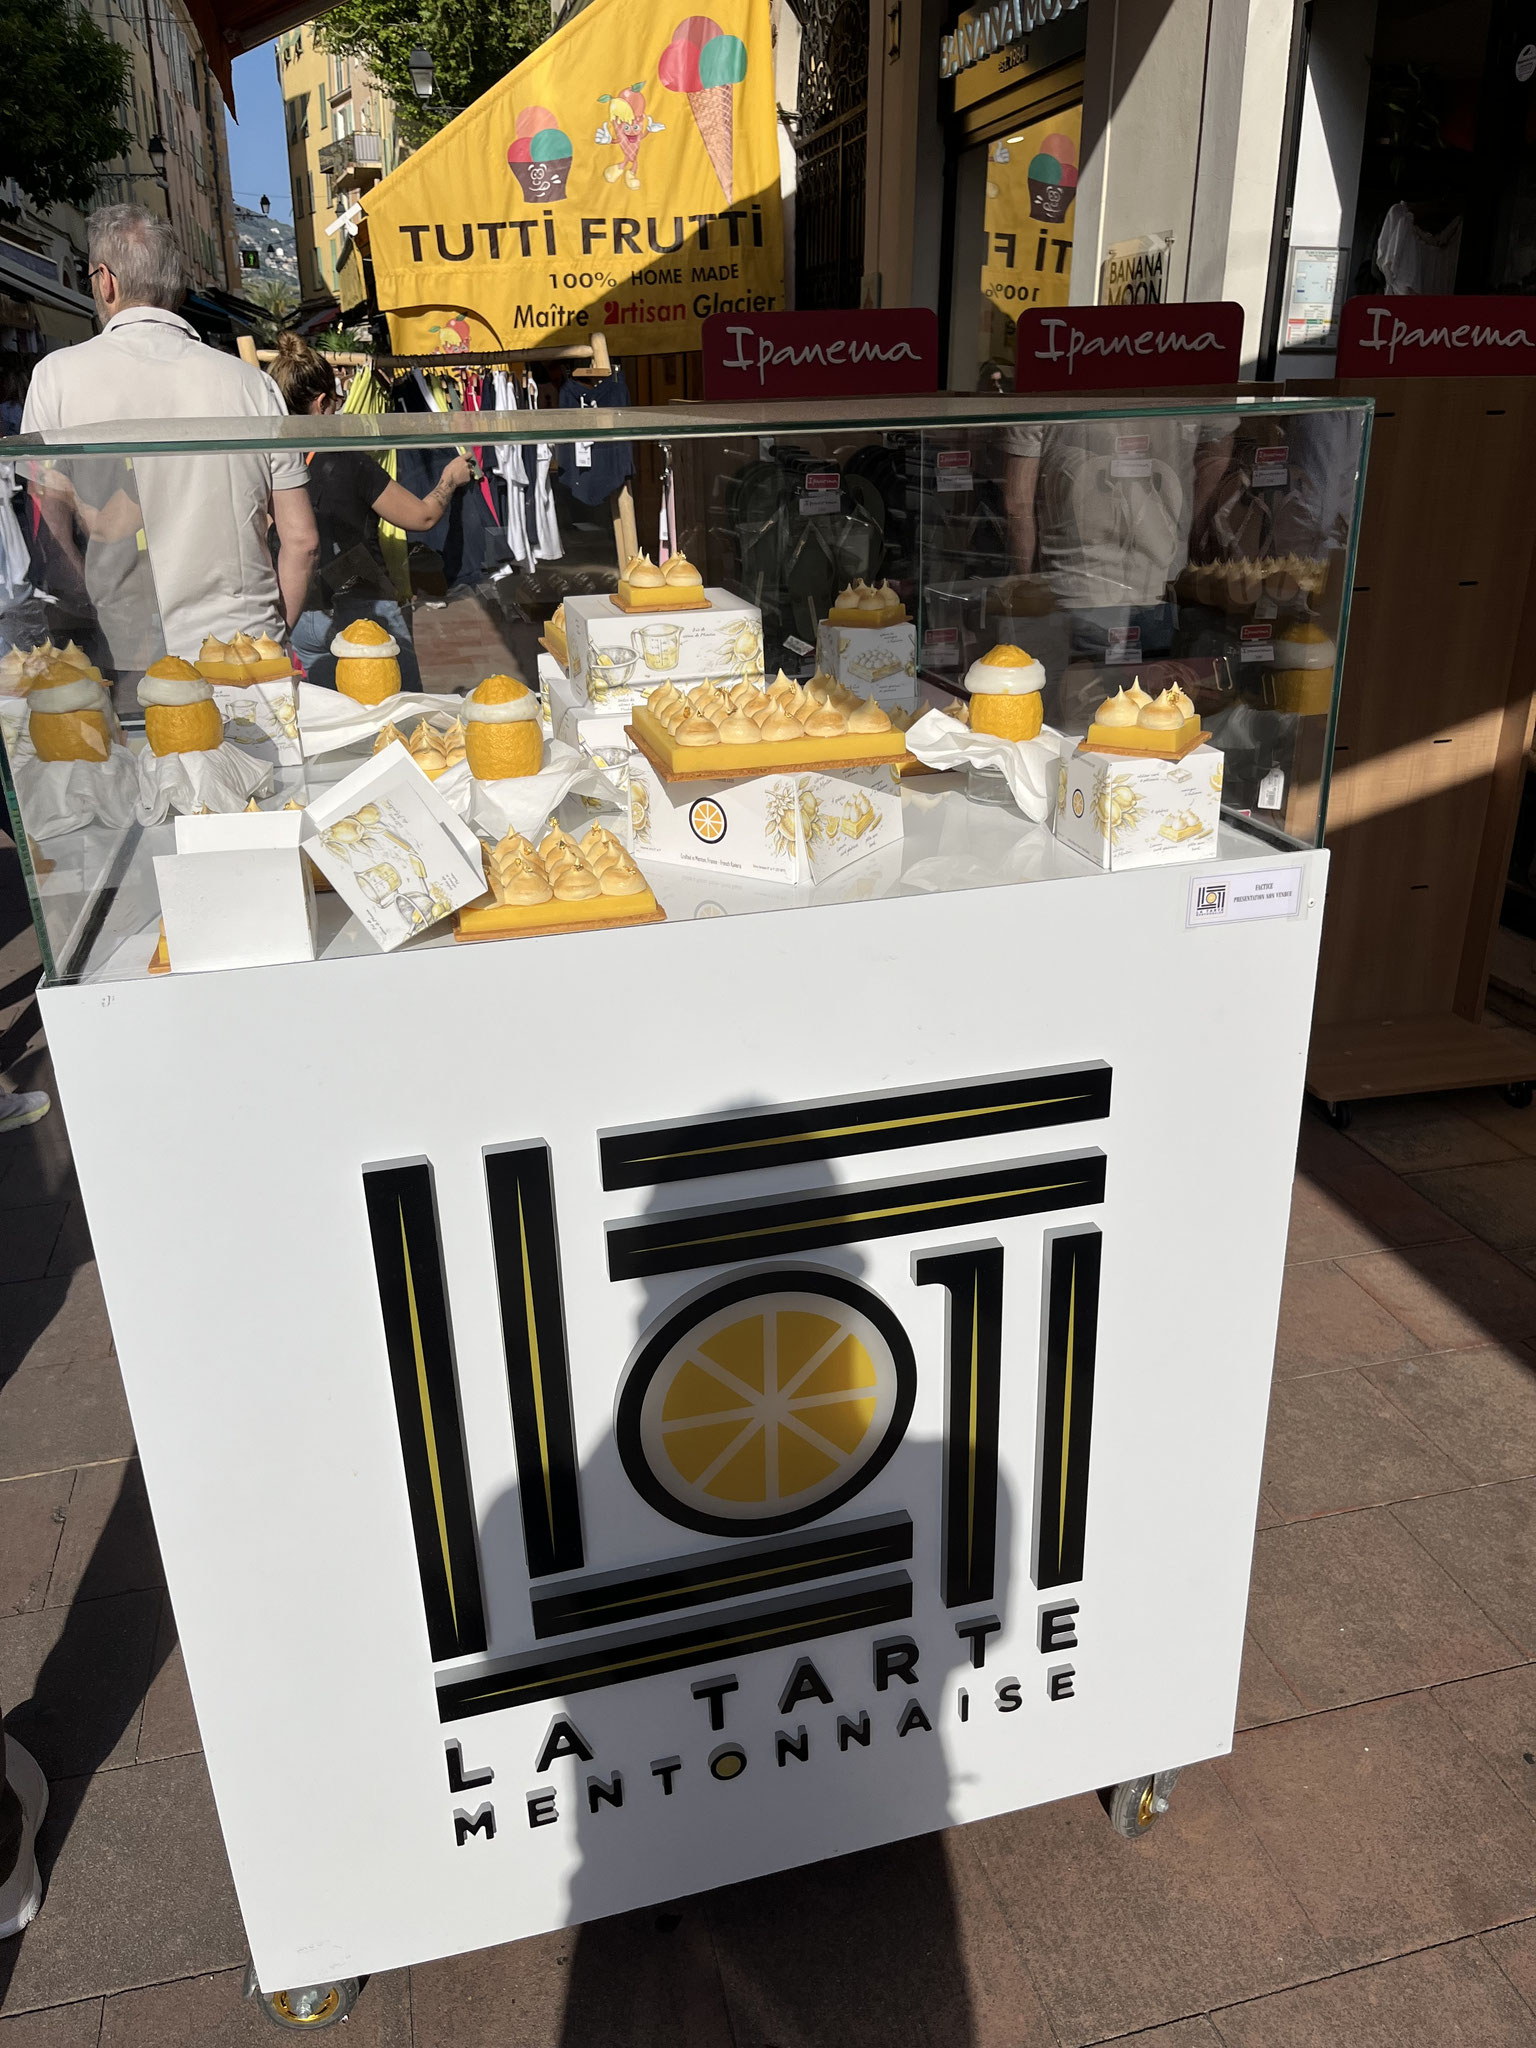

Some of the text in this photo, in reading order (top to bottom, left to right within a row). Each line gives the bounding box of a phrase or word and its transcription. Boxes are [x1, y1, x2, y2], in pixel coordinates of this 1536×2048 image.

[549, 264, 739, 290] 100% HOME MADE
[1110, 252, 1163, 284] BANANA
[513, 304, 589, 329] Maître
[1359, 308, 1536, 364] Ipanema
[722, 325, 922, 385] Ipanema
[1034, 319, 1226, 375] Ipanema
[444, 1597, 1080, 1794] LA TARTE
[452, 1662, 1076, 1847] MENTONNAISE
